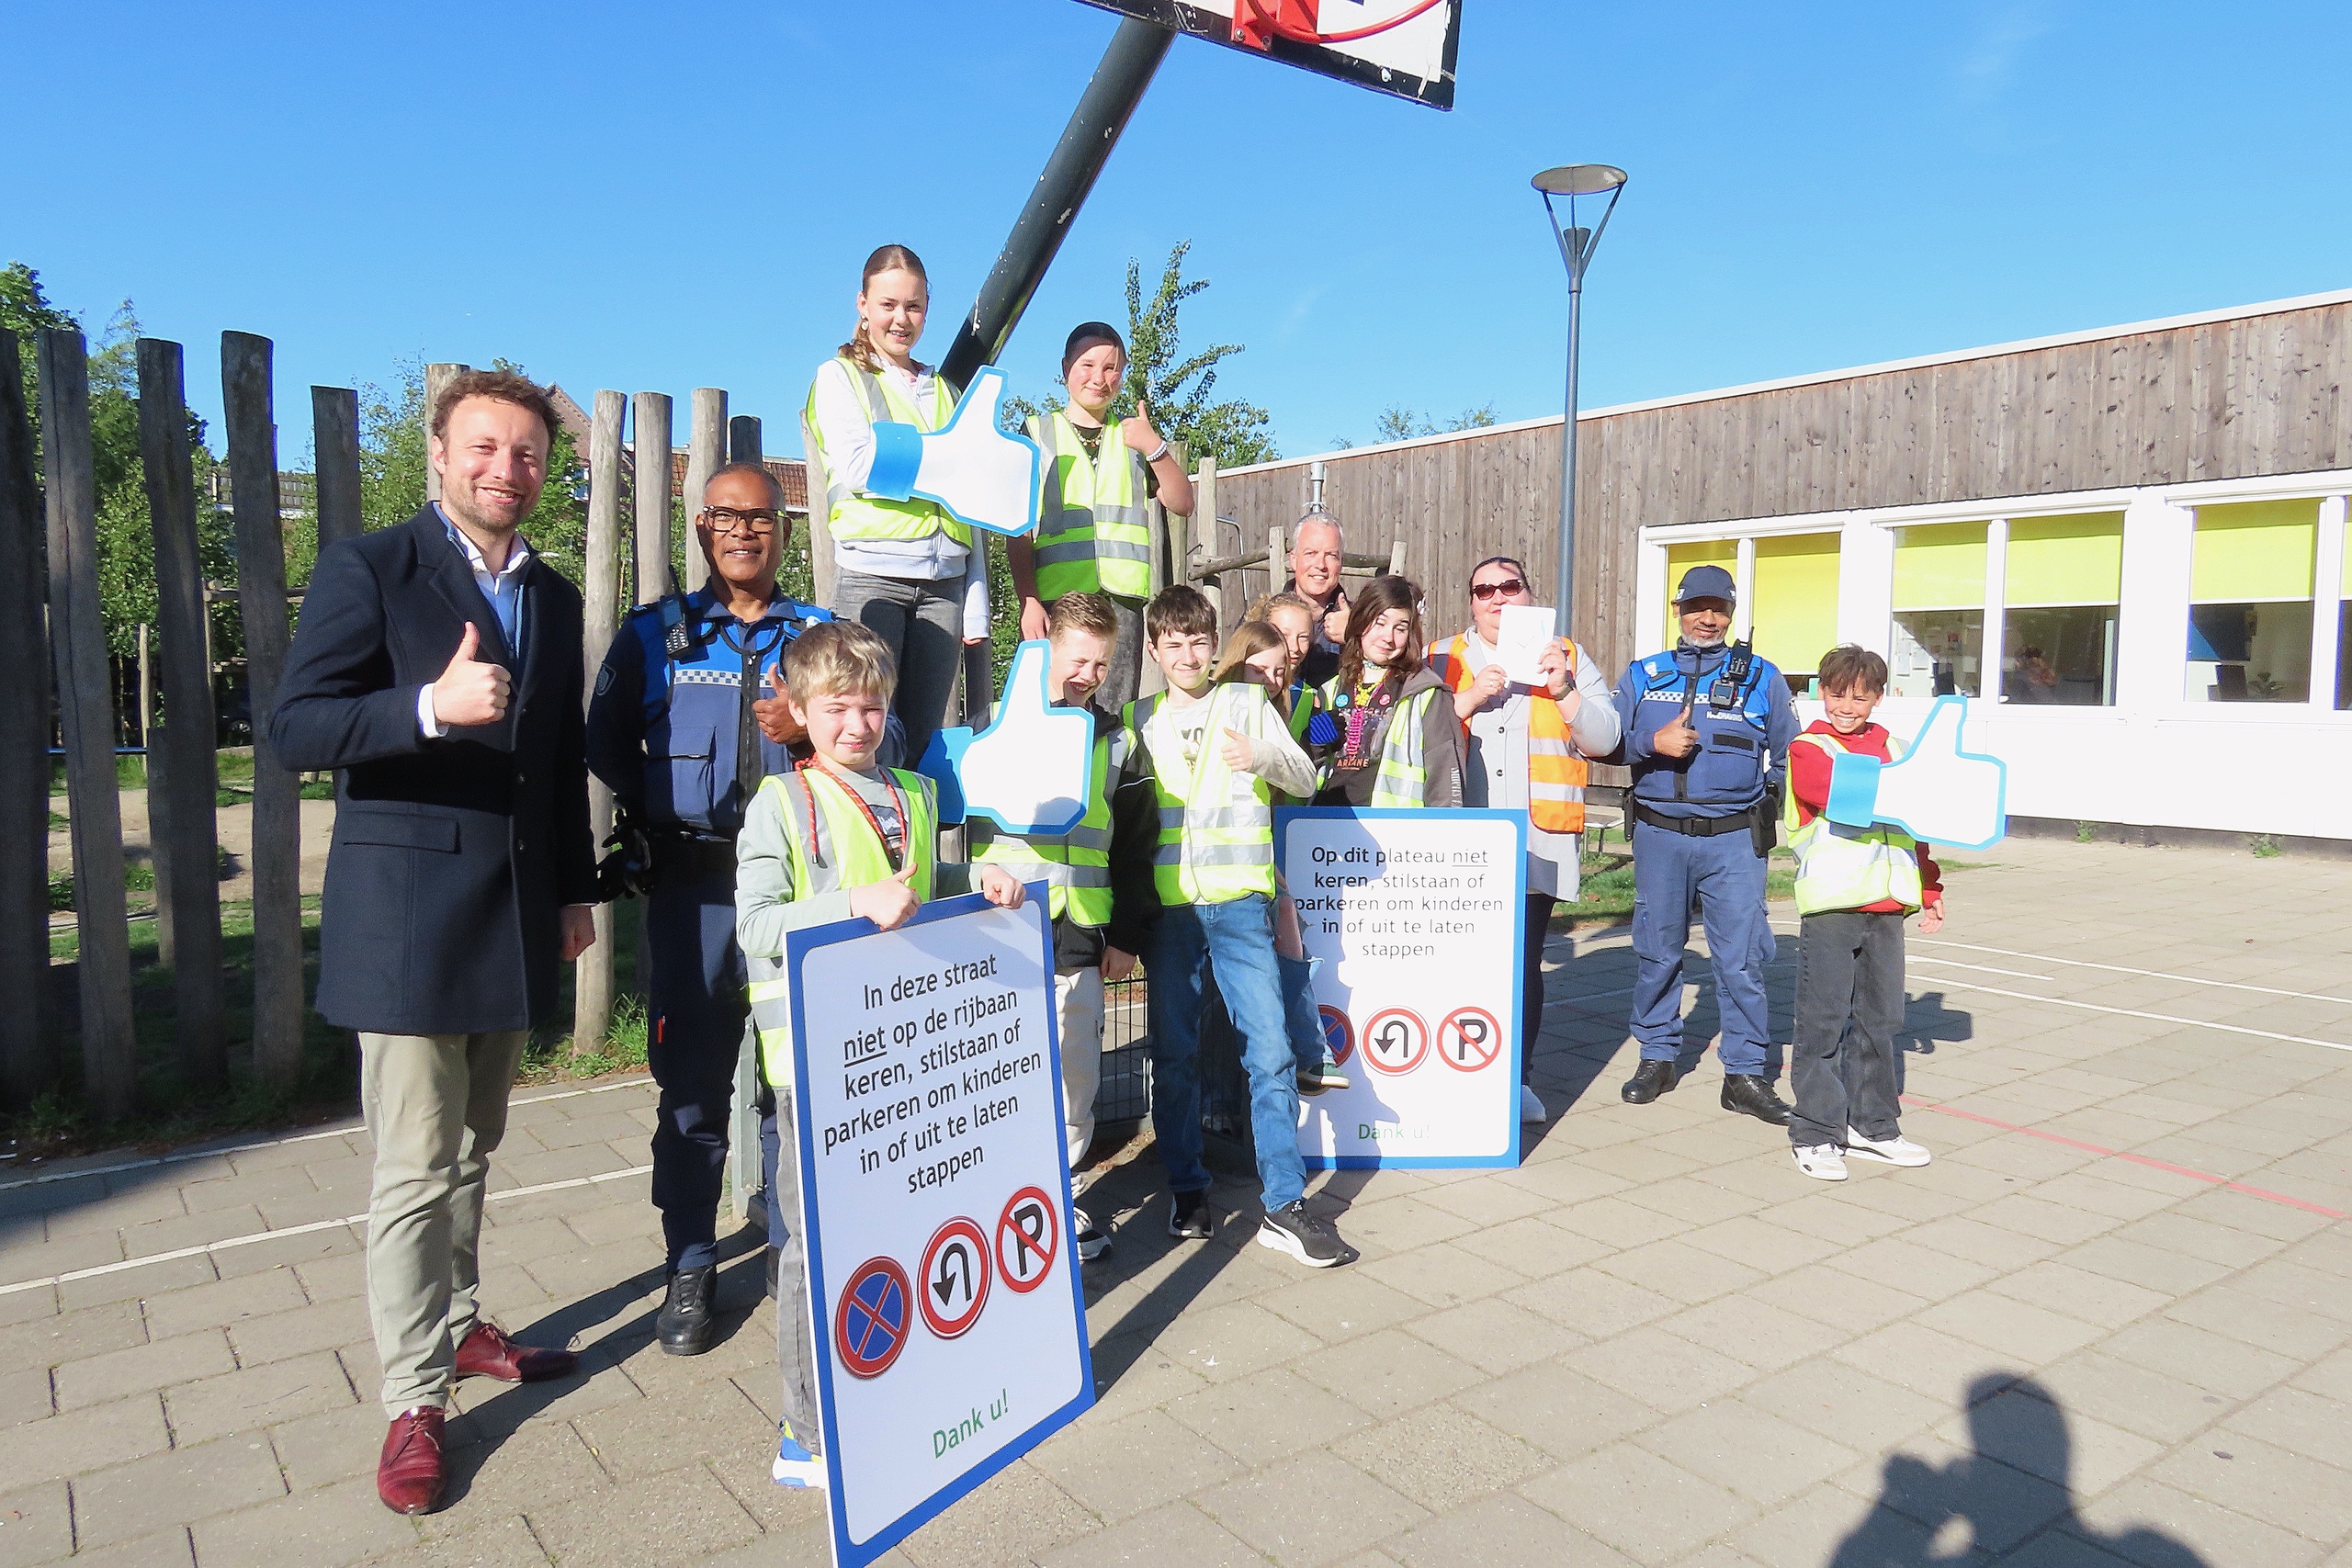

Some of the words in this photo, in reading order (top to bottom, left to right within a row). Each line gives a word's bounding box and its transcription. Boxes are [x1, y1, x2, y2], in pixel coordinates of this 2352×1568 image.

[1312, 847, 1337, 866] Op
[1344, 847, 1369, 863] dit
[1375, 847, 1444, 866] plateau
[1453, 849, 1487, 863] niet
[1295, 895, 1378, 910] parkeren
[1387, 900, 1413, 910] om
[1422, 897, 1502, 910] kinderen
[1315, 872, 1375, 890] keren,
[1383, 873, 1459, 888] stilstaan
[1467, 874, 1485, 888] of
[1322, 918, 1339, 933] in
[1347, 919, 1364, 933] of
[1373, 919, 1396, 933] uit
[1404, 920, 1421, 933] te
[1430, 919, 1474, 933] laten
[1363, 943, 1434, 960] stappen
[865, 984, 883, 1010] In
[890, 974, 937, 1002] deze
[944, 953, 997, 987] straat
[844, 1026, 887, 1061] niet
[893, 1021, 917, 1047] op
[924, 1010, 948, 1034] de
[955, 991, 1017, 1028] rijbaan
[845, 1063, 912, 1100] keren,
[921, 1032, 998, 1074] stilstaan
[1004, 1018, 1021, 1044] of
[824, 1096, 921, 1156] parkeren
[928, 1083, 956, 1108] om
[963, 1053, 1041, 1096] kinderen
[860, 1148, 879, 1175] in
[888, 1131, 908, 1163] of
[915, 1122, 942, 1152] uit
[947, 1116, 967, 1138] te
[974, 1096, 1018, 1128] laten
[1359, 1122, 1404, 1139] Dank
[1414, 1124, 1430, 1138] u!
[908, 1146, 983, 1193] stappen
[933, 1407, 984, 1459] Dank
[990, 1388, 1008, 1421] u!
